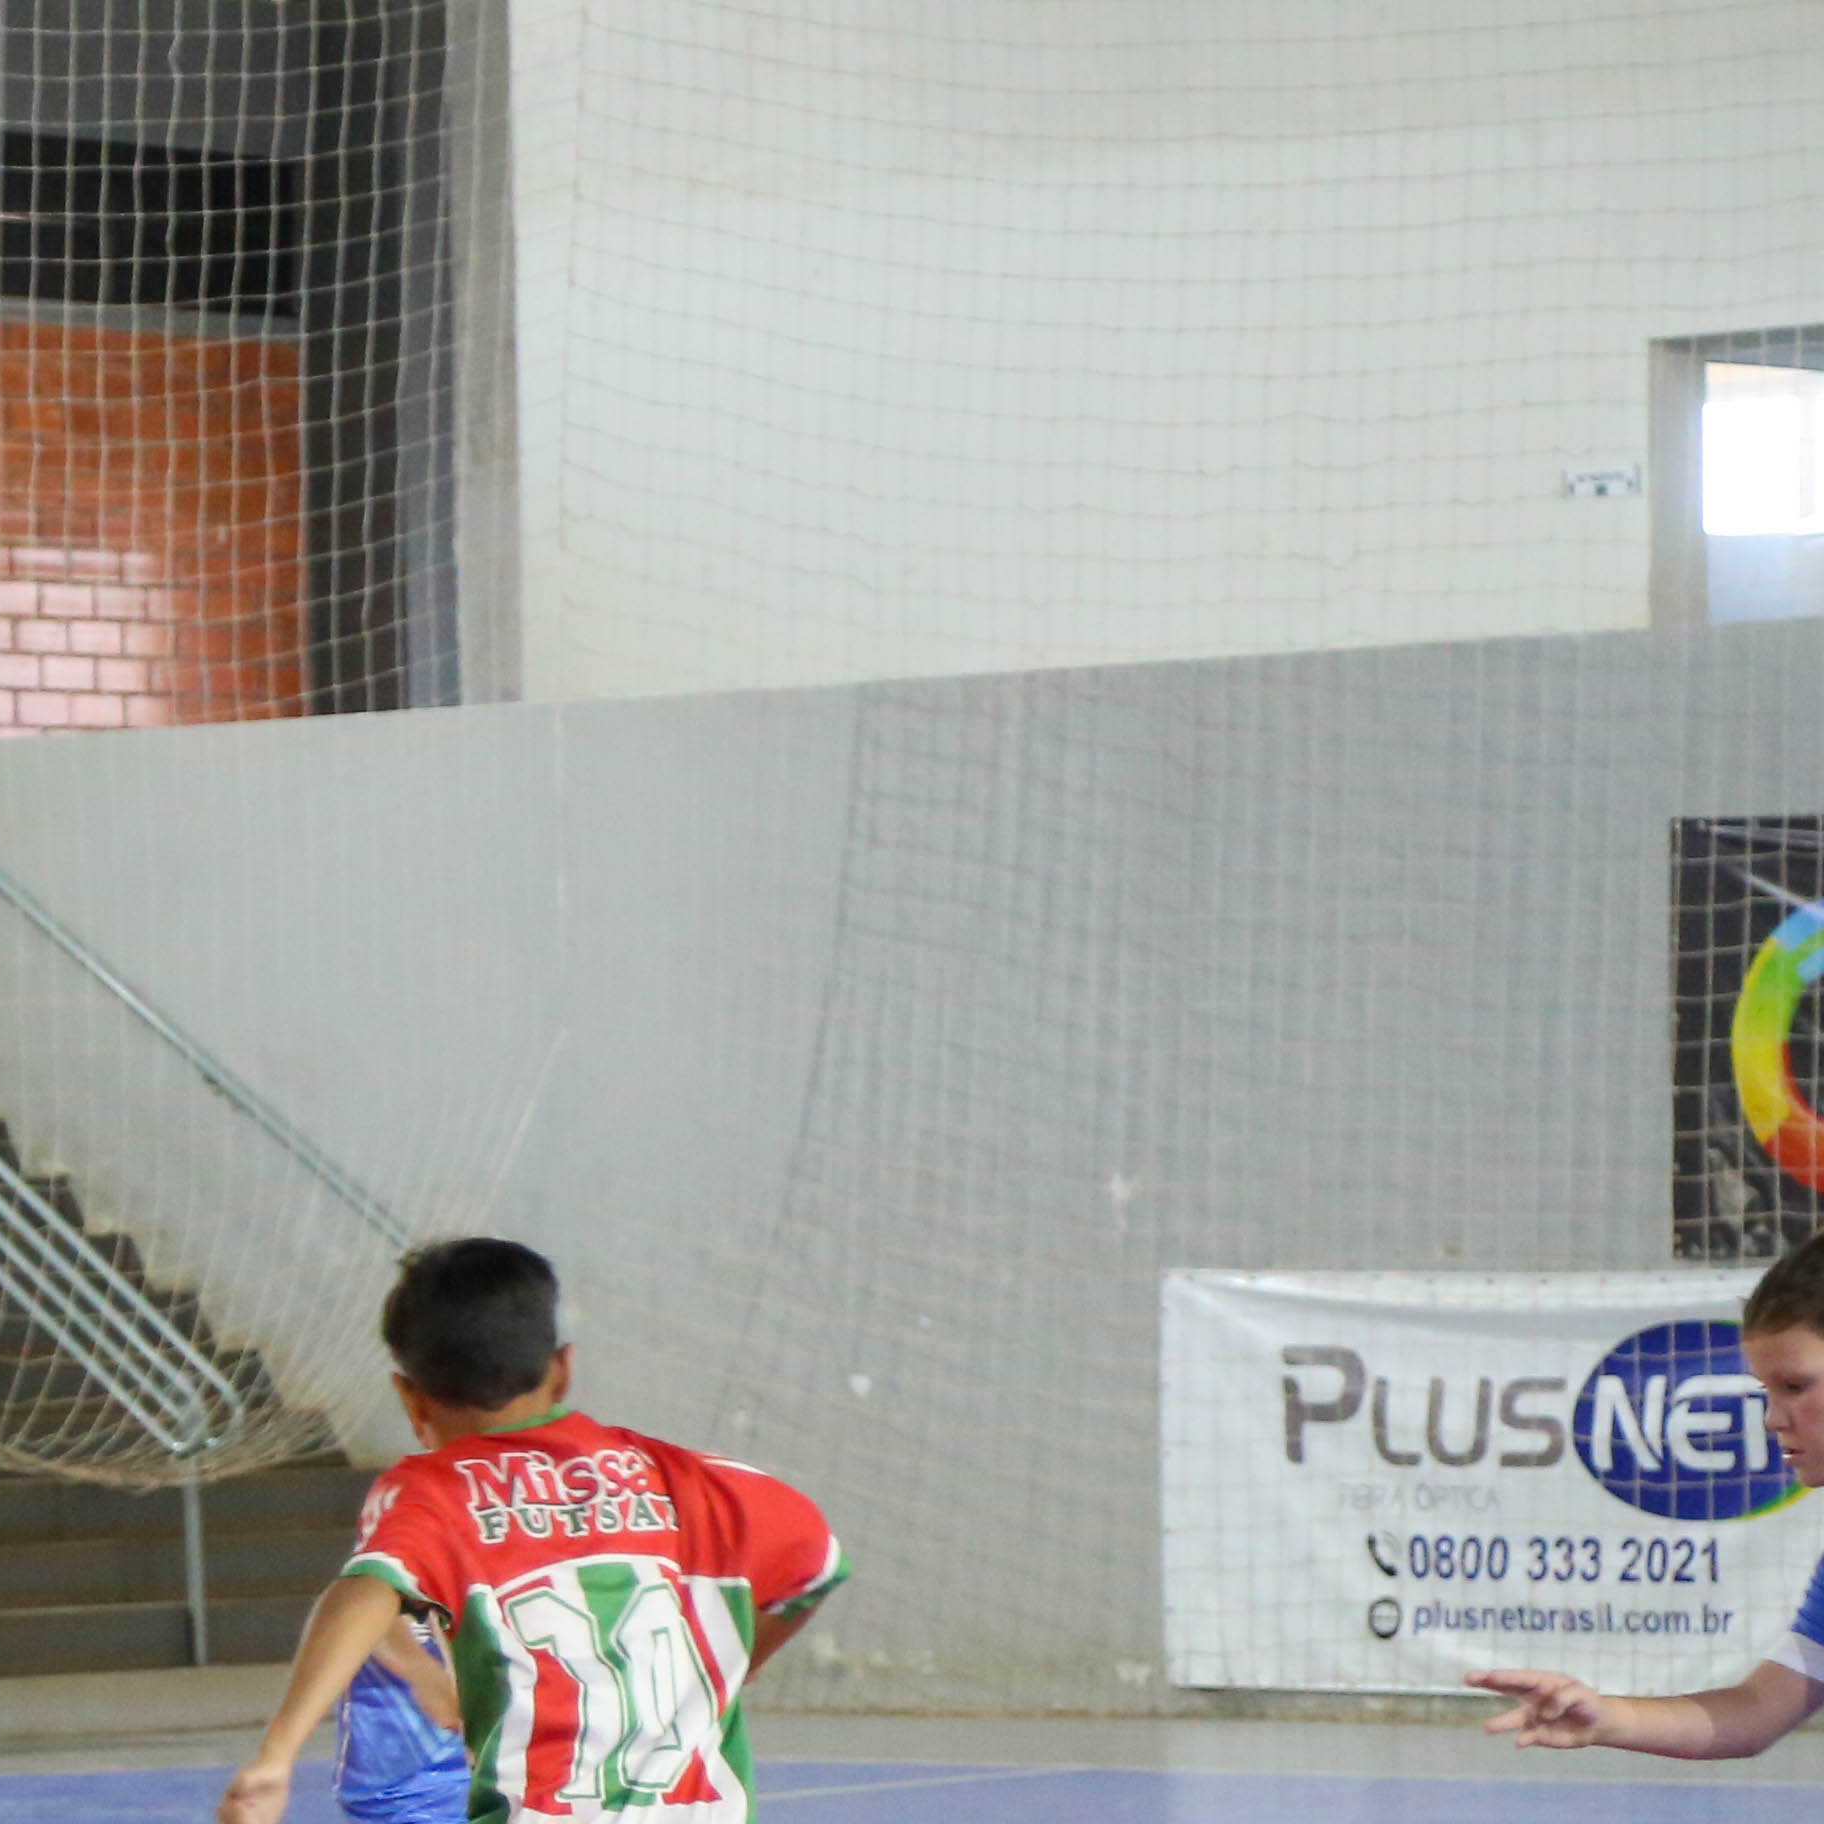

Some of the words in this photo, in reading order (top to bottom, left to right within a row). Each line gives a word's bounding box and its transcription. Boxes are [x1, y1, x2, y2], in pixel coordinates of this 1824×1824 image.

[1409, 1535, 1509, 1580] 0800
[1528, 1536, 1602, 1582] 333
[1620, 1537, 1719, 1583] 2021
[1413, 1602, 1734, 1635] plusnetbrasil.com.br
[505, 1584, 718, 1801] 10
